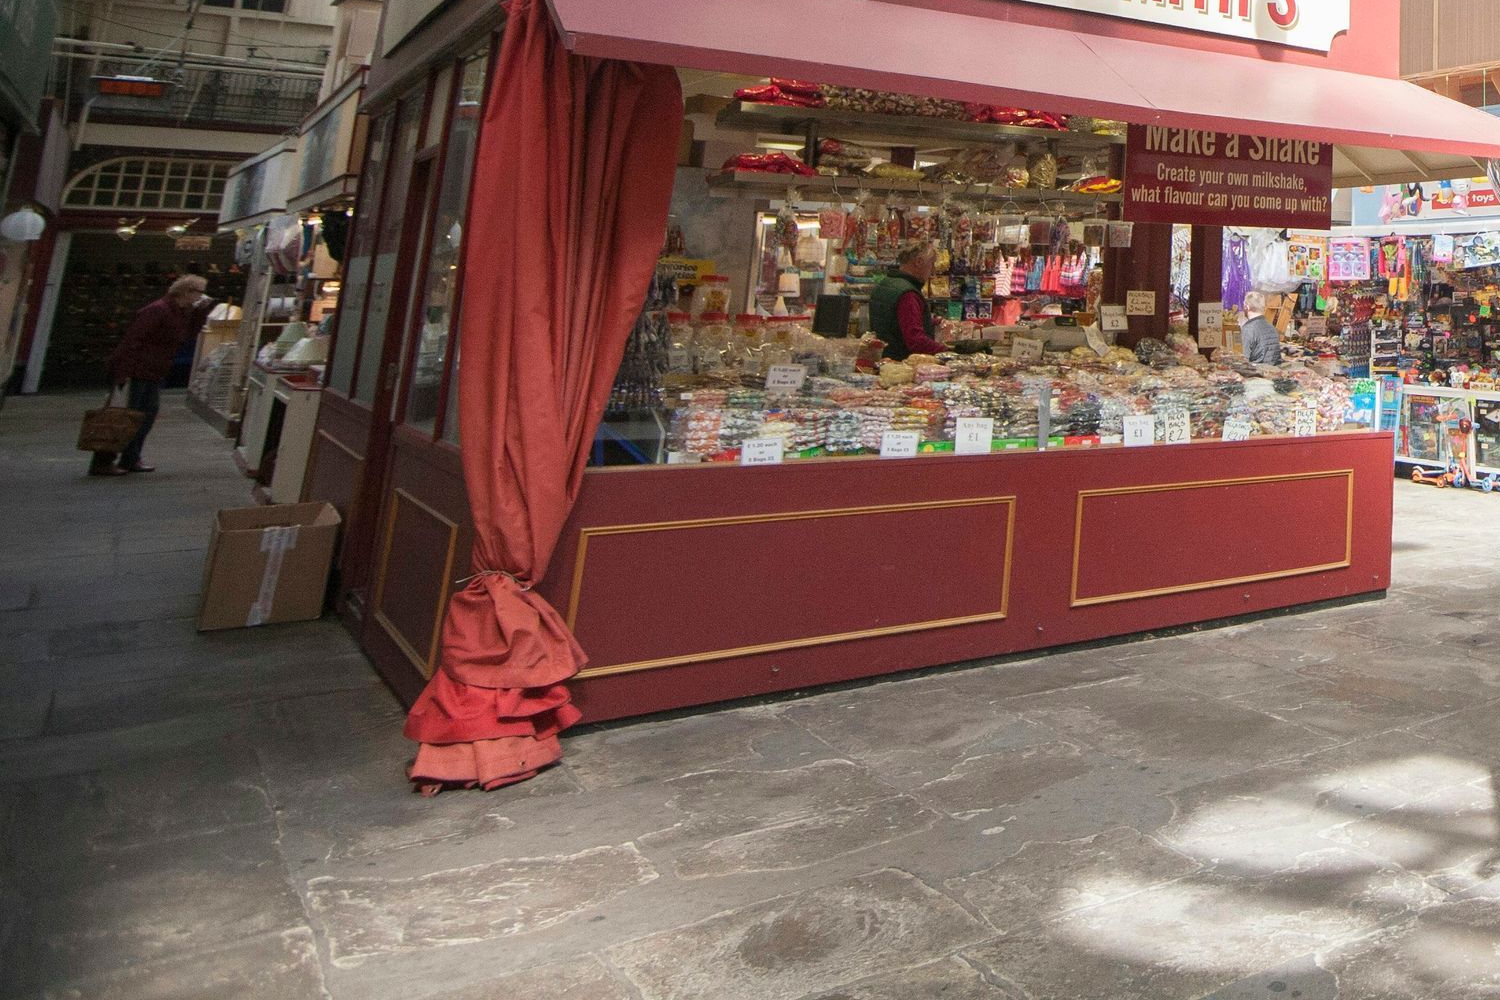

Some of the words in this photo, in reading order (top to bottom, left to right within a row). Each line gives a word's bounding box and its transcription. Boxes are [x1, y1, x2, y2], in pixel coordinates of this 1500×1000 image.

[1157, 162, 1196, 183] Create
[1199, 169, 1225, 187] your
[1227, 173, 1249, 185] own
[1252, 171, 1308, 193] milkshake,
[1131, 184, 1161, 204] what
[1164, 187, 1204, 206] flavour
[1207, 193, 1228, 207] can
[1230, 194, 1250, 211] you
[1253, 196, 1282, 210] come
[1285, 198, 1298, 214] up
[1300, 195, 1328, 213] with?
[1471, 191, 1495, 205] toys
[1206, 316, 1215, 324] £2
[1134, 428, 1143, 438] £1
[1168, 428, 1185, 442] £2
[1298, 425, 1312, 436] £2
[968, 432, 979, 442] £1
